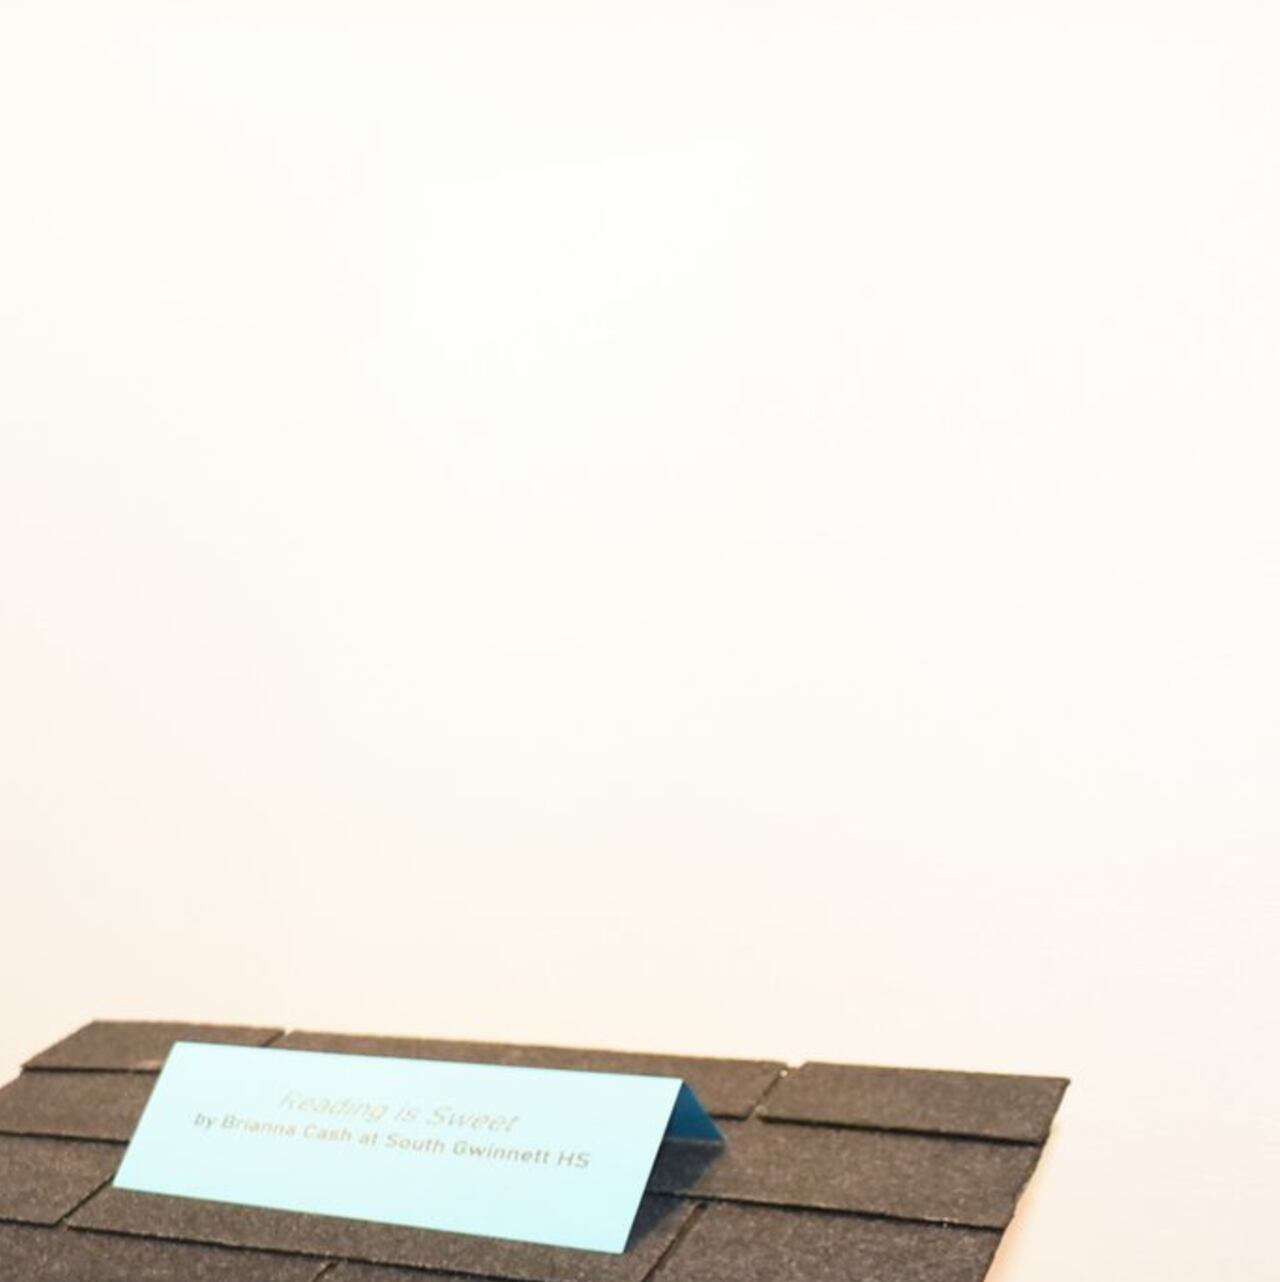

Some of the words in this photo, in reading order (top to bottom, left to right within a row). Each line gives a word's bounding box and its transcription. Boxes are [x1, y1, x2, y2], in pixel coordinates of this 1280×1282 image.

[194, 1112, 216, 1129] by
[222, 1113, 296, 1137] Brianna
[303, 1122, 352, 1143] Cash
[358, 1131, 379, 1146] at
[384, 1132, 445, 1154] South
[452, 1140, 550, 1165] Gwinnett
[558, 1150, 590, 1168] HS
[394, 1105, 417, 1122] is
[426, 1105, 519, 1133] Sweet
